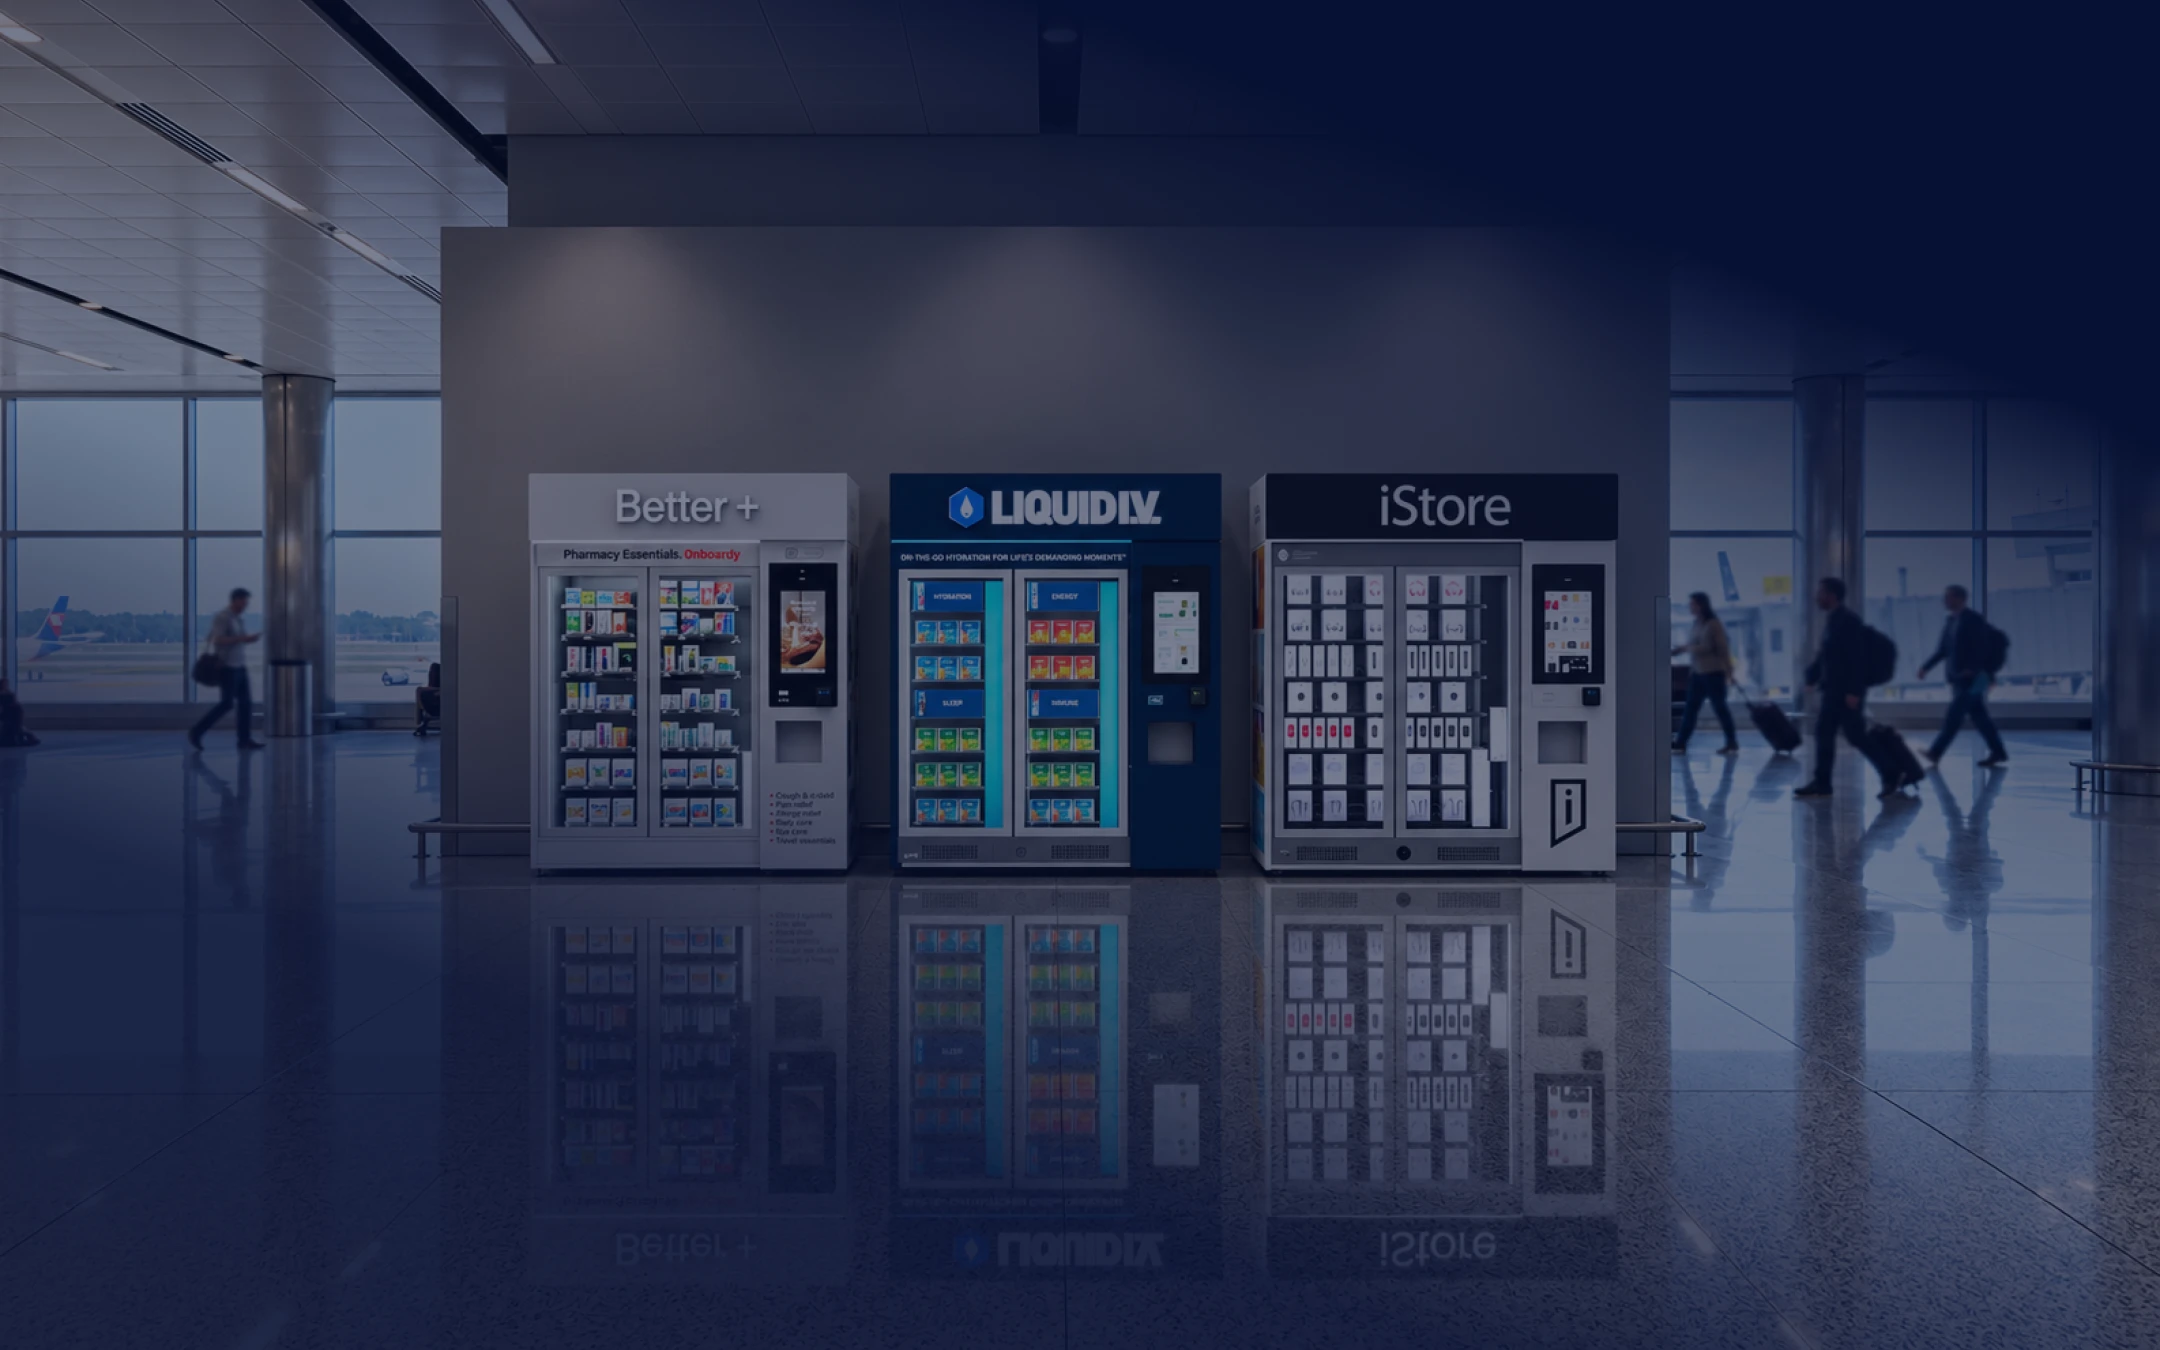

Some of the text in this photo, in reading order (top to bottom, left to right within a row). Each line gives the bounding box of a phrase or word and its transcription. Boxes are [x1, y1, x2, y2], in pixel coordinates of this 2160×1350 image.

[615, 488, 728, 524] Better
[1380, 484, 1512, 527] iStore
[563, 549, 741, 562] Pharmacy Essentials. Onboardy
